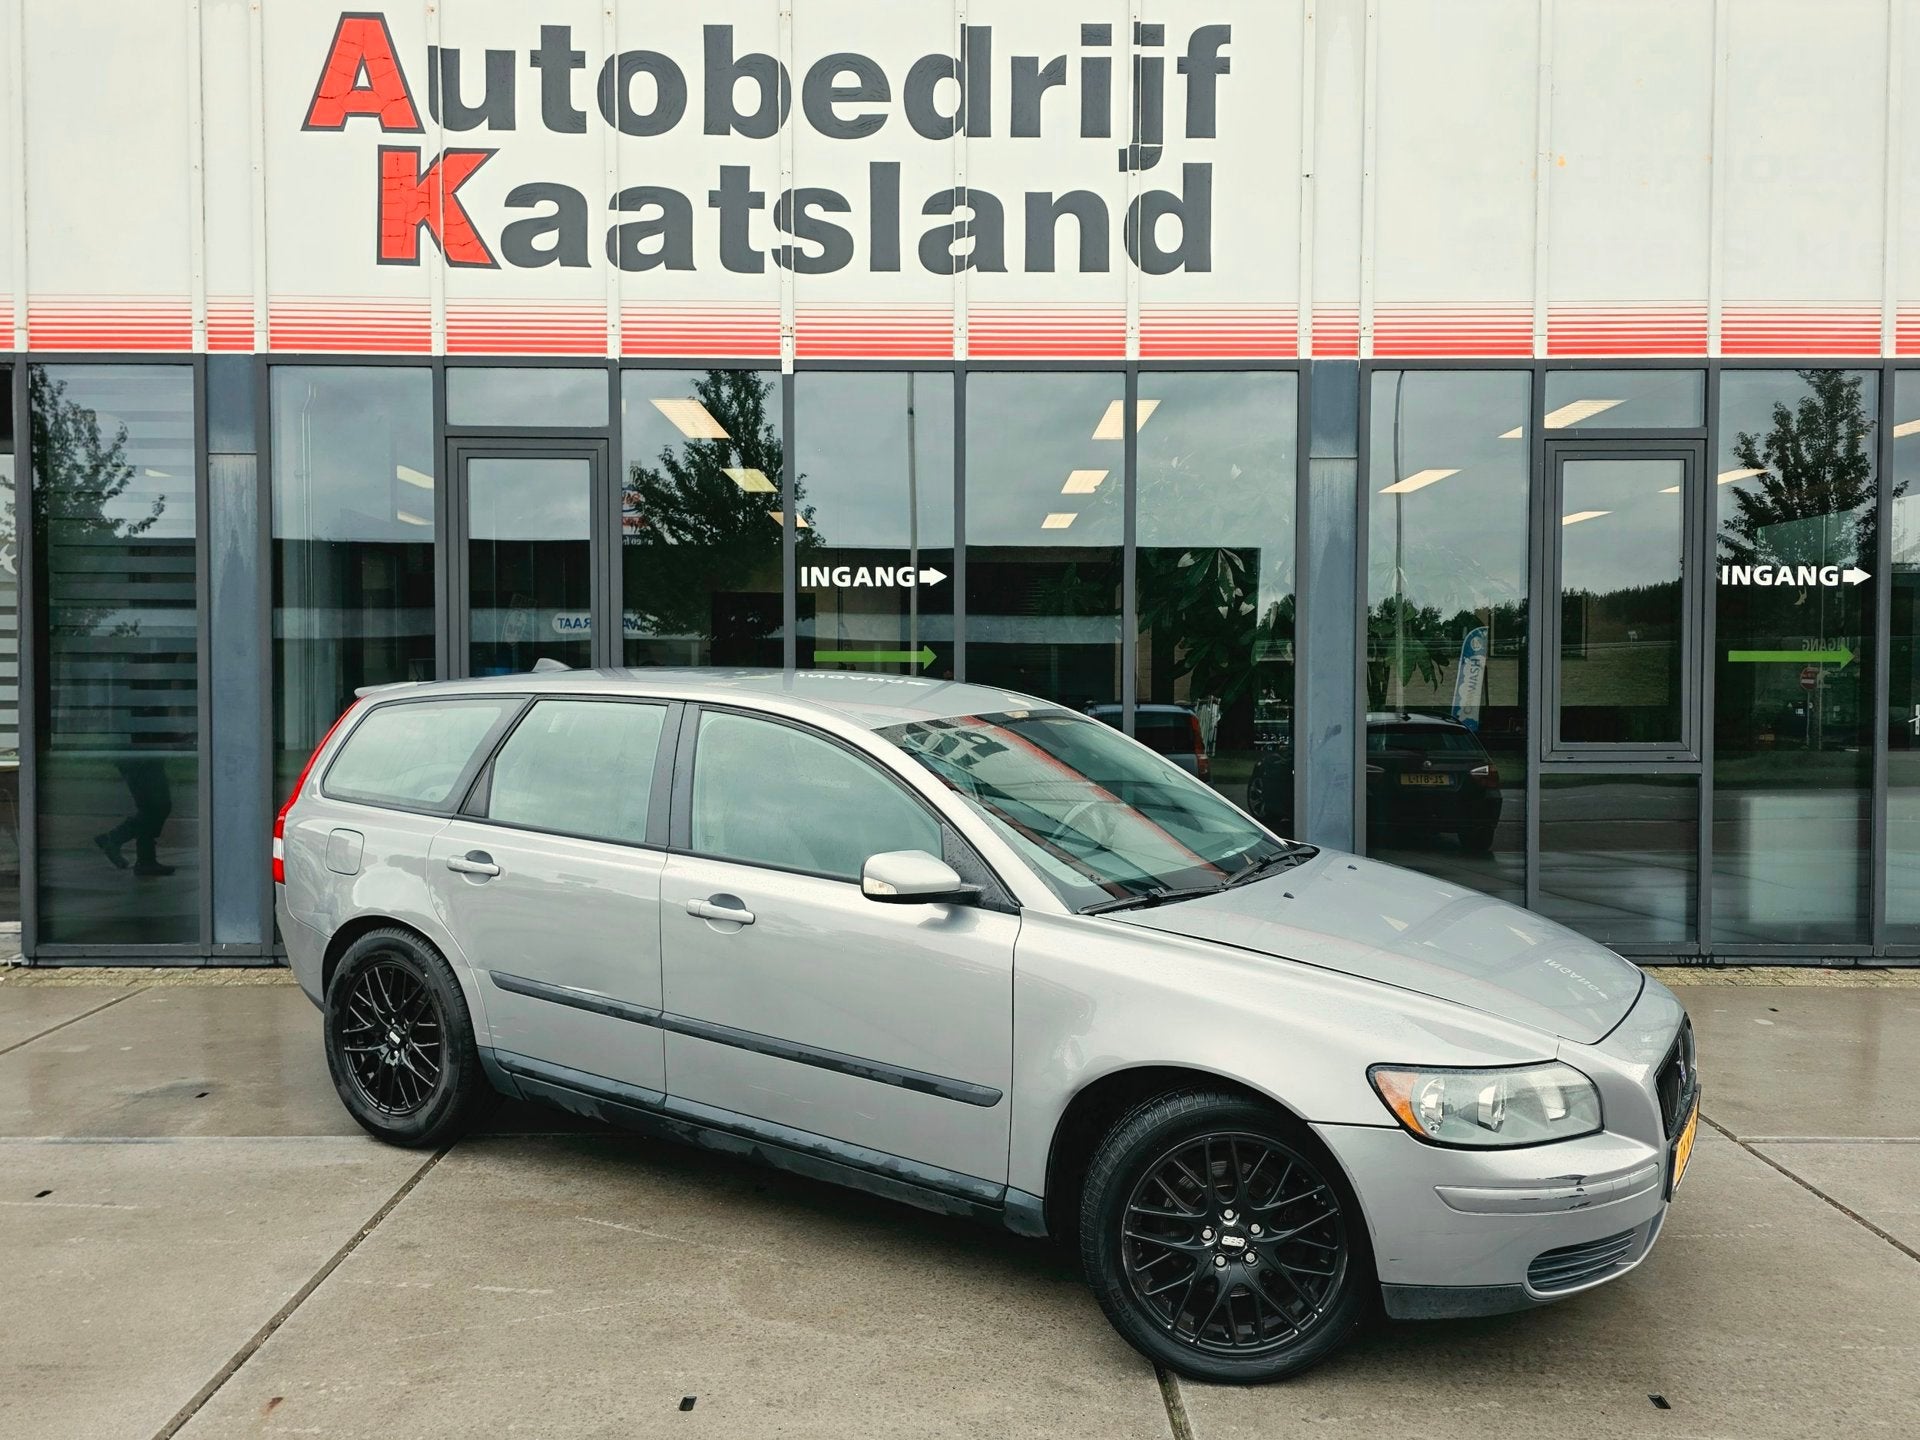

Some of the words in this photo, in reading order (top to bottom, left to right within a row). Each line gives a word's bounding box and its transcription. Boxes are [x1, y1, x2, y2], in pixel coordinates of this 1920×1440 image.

[303, 11, 1232, 172] Autobedrijf
[376, 144, 1213, 273] Kaatsland
[800, 566, 915, 588] INGANG
[1721, 565, 1839, 586] INGANG
